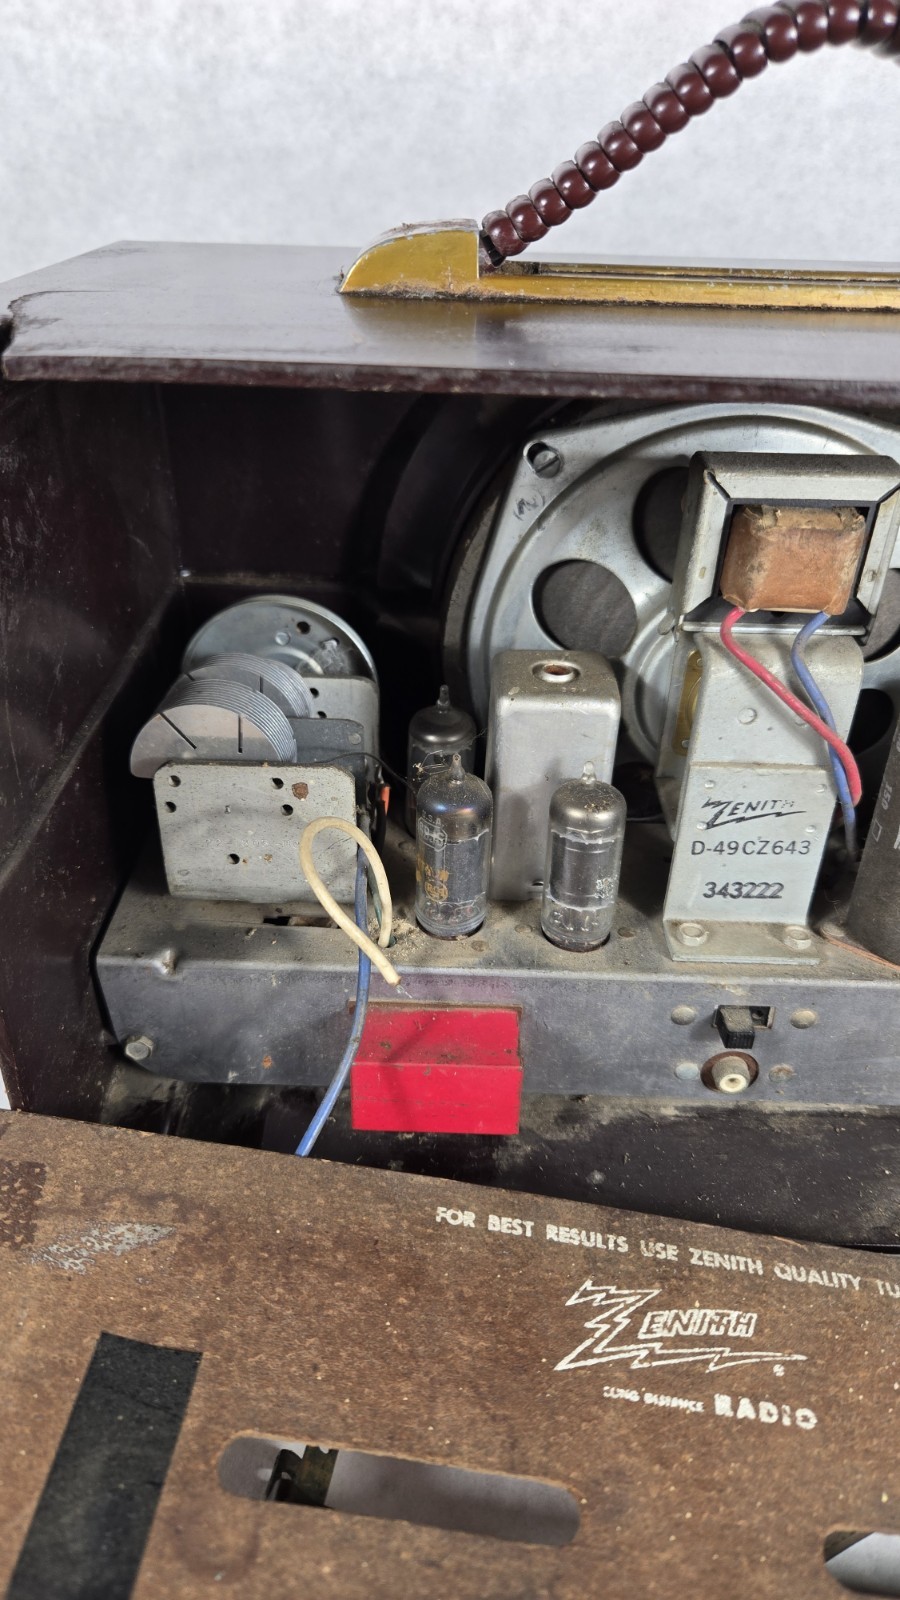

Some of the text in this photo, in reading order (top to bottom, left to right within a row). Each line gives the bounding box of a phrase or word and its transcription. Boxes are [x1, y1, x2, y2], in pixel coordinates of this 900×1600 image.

[701, 798, 807, 830] ZENITH
[691, 840, 811, 856] D-49CZ643
[702, 881, 785, 899] 343222
[435, 1206, 476, 1228] FOR
[487, 1214, 535, 1237] BEST
[545, 1223, 629, 1253] RESULTS
[639, 1239, 679, 1262] USE
[688, 1247, 764, 1276] ZENITH
[774, 1262, 861, 1291] QUALITY
[553, 1278, 809, 1374] ZENITH
[714, 1393, 818, 1430] RADIO
